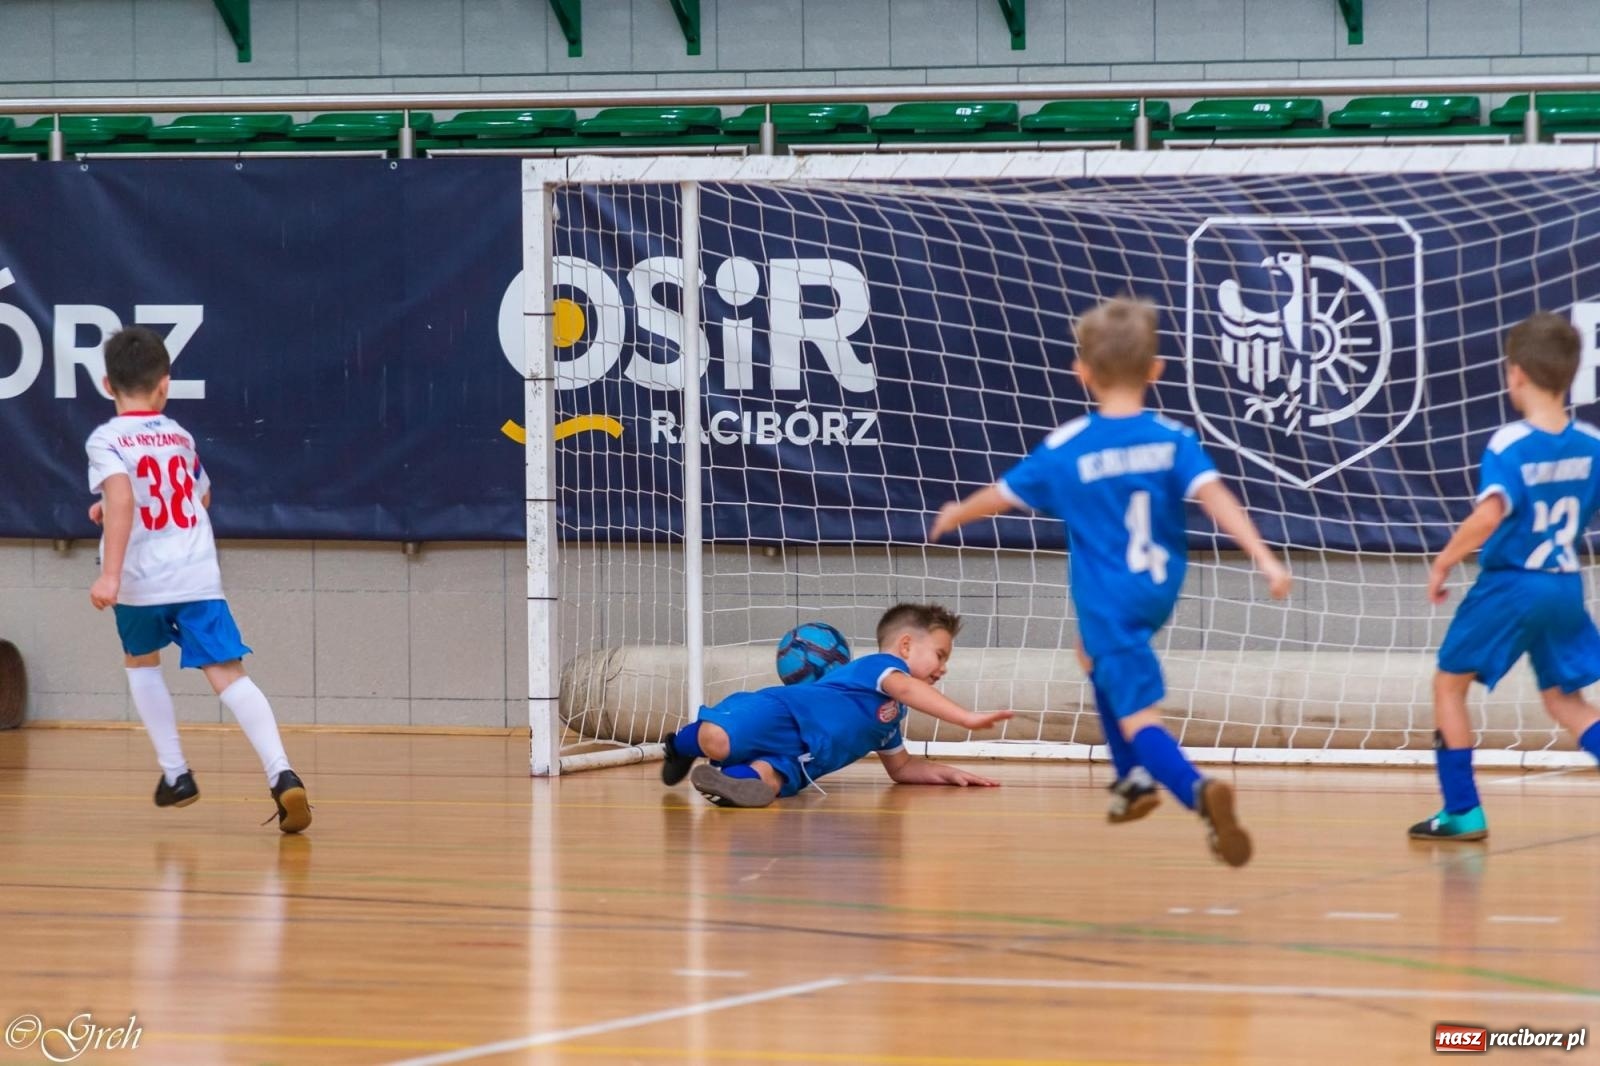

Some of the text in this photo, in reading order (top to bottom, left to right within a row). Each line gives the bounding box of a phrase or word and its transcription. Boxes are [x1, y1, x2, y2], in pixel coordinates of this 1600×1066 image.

[498, 255, 878, 392] OSiR
[136, 455, 197, 531] 38
[1124, 489, 1170, 585] 4
